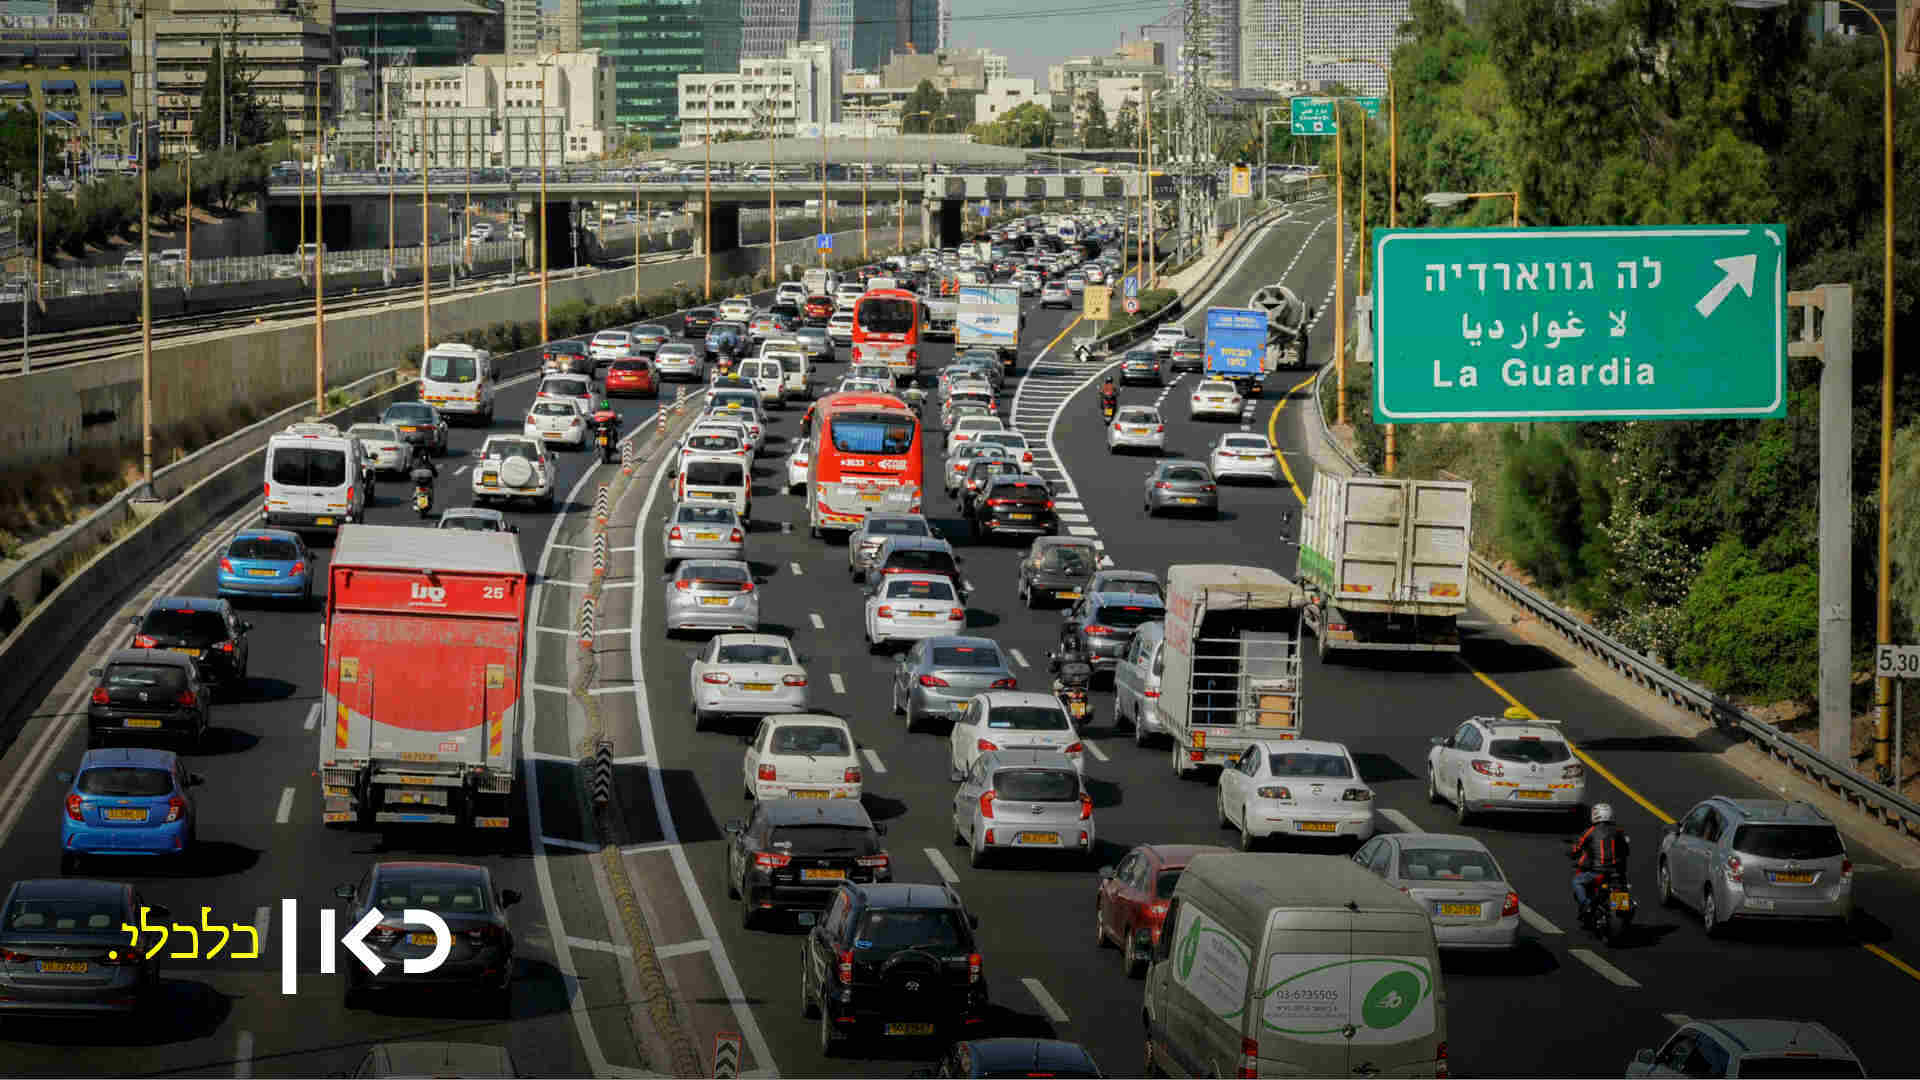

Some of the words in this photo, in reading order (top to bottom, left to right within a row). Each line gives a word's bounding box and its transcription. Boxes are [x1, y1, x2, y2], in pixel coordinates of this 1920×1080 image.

[1425, 262, 1595, 292] גווארדיה
[1617, 255, 1661, 289] לה
[1609, 310, 1628, 337] لا
[1433, 359, 1478, 388] La
[1502, 357, 1655, 387] Guardia
[1879, 649, 1919, 672] 5.30
